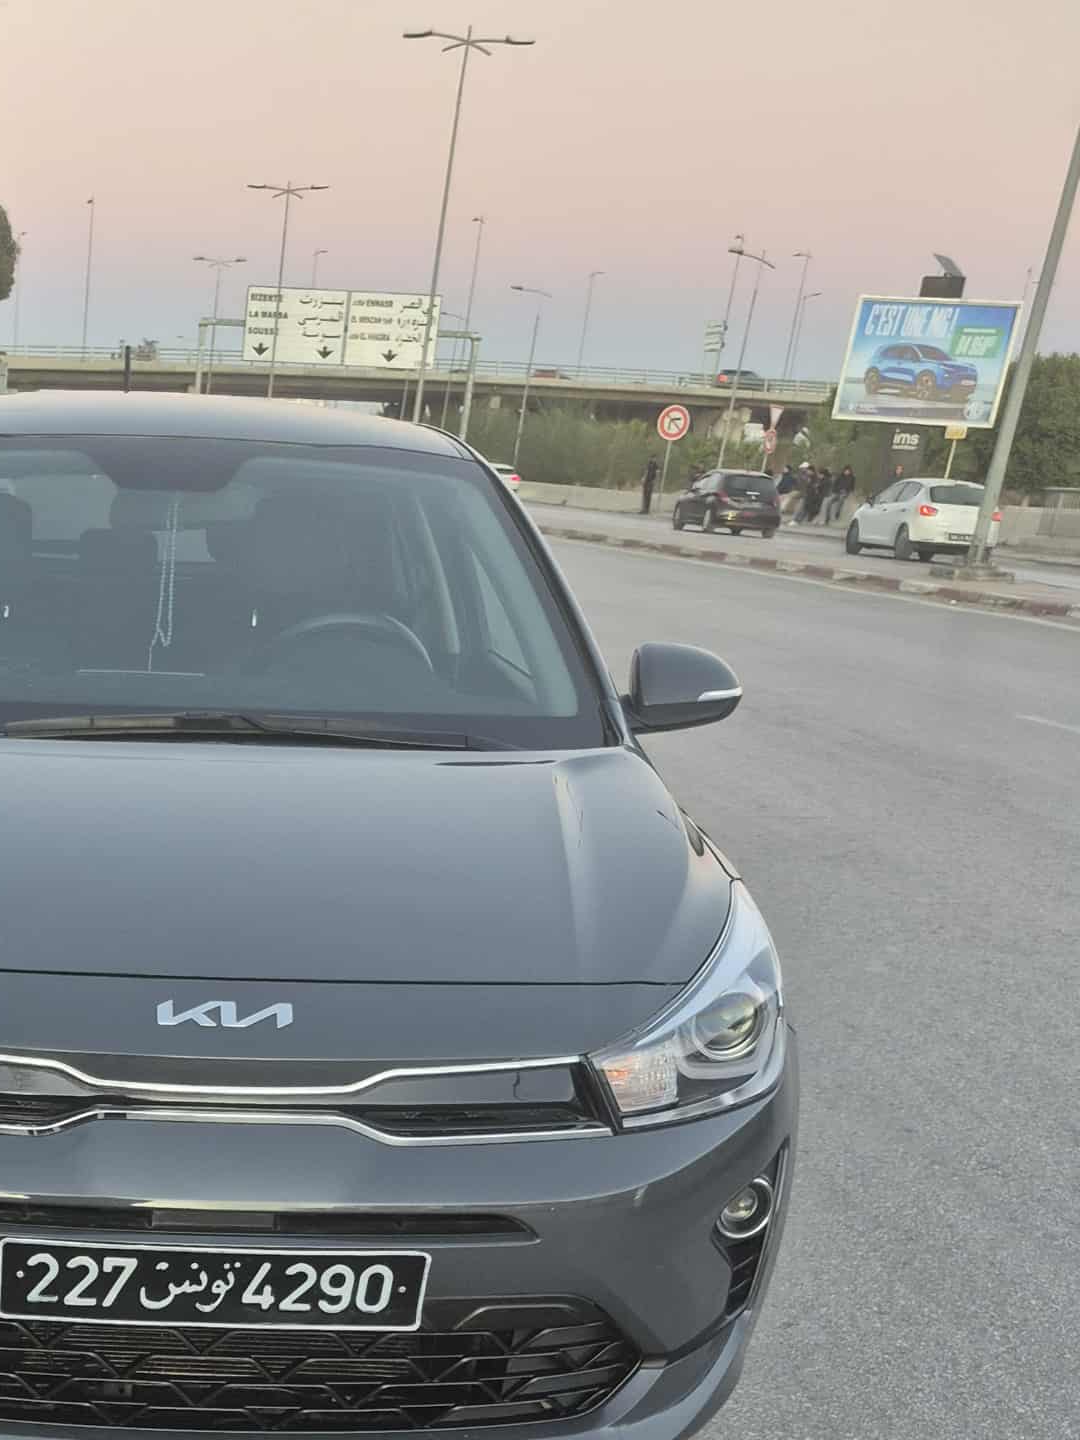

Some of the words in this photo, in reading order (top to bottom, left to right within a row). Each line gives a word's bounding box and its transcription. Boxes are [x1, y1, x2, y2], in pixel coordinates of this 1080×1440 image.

[248, 310, 259, 318] LA
[893, 428, 920, 445] ims
[157, 998, 294, 1029] KIA
[25, 1252, 138, 1308] 227
[139, 1260, 240, 1314] تونس
[241, 1261, 394, 1314] 4290
